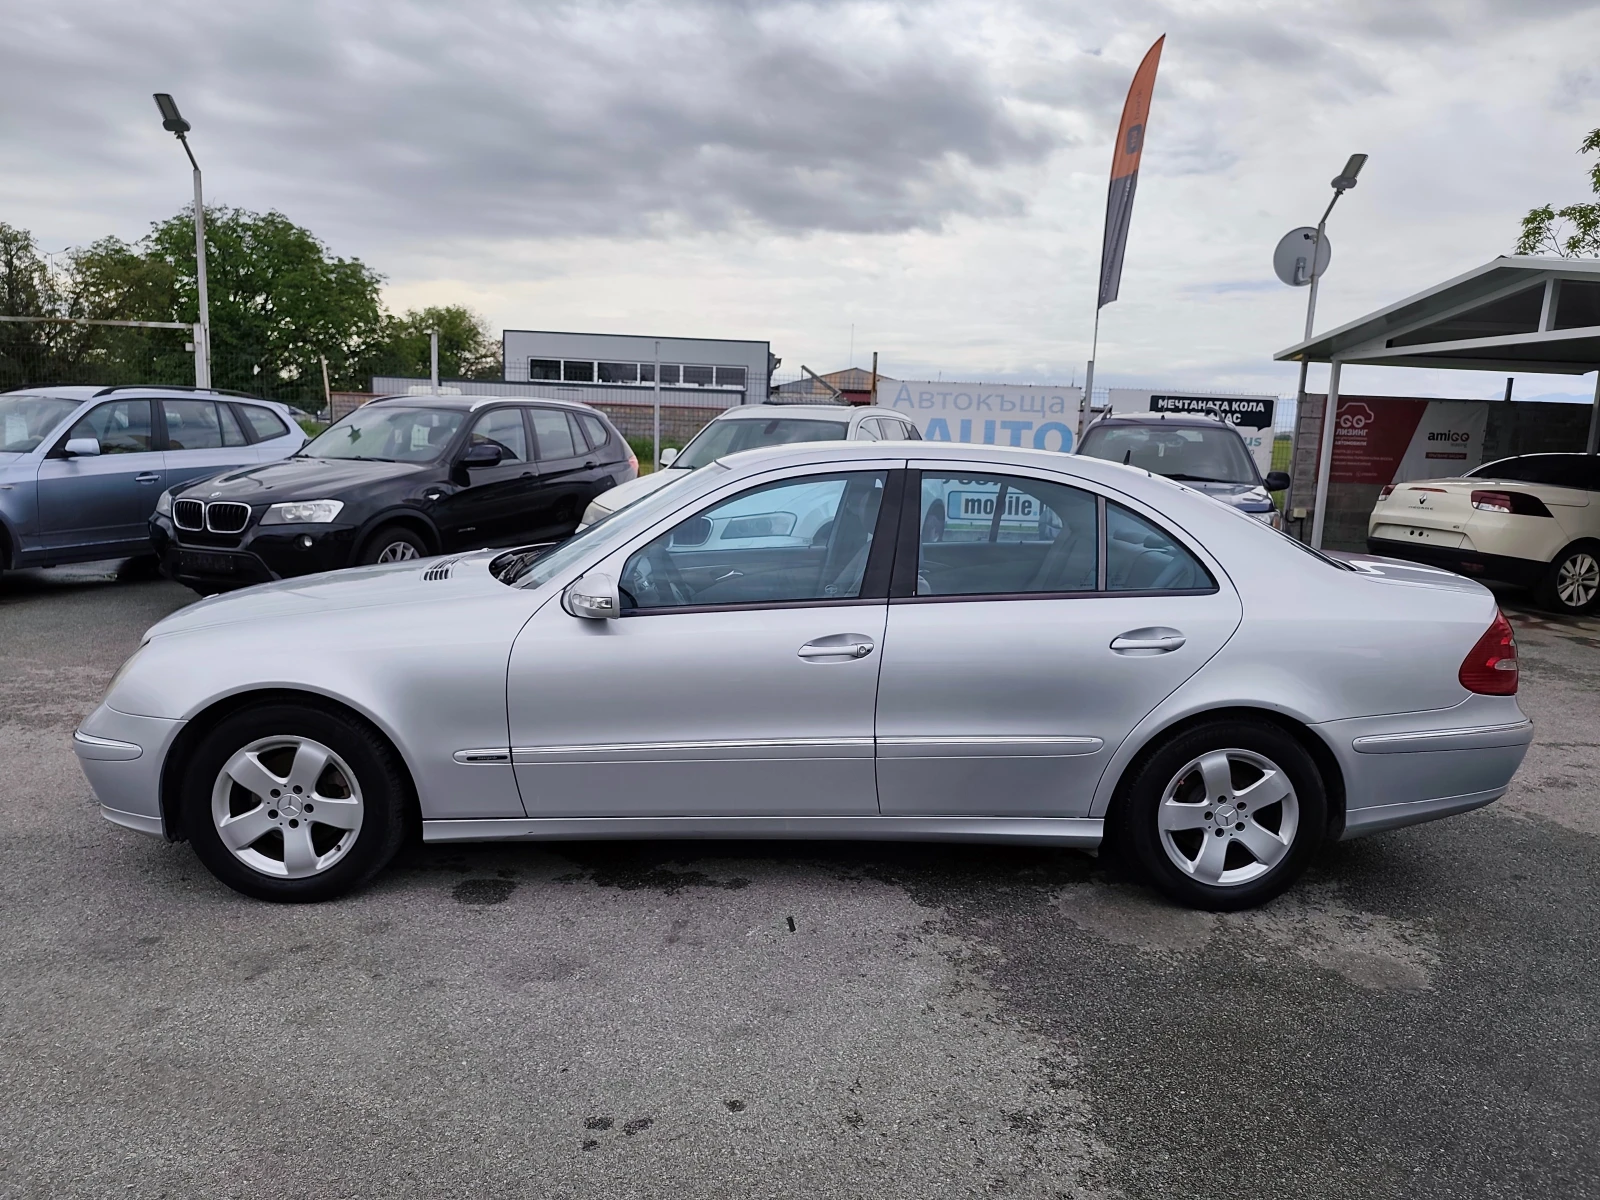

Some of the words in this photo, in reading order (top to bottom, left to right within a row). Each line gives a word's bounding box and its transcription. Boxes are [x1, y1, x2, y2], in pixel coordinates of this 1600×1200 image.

[892, 383, 1066, 418] Автокъща
[1157, 399, 1229, 412] МЕЧТАНАТА
[1231, 401, 1265, 412] КОЛА
[924, 418, 1074, 453] AUTO
[1335, 428, 1368, 436] ЛИЗИНГ
